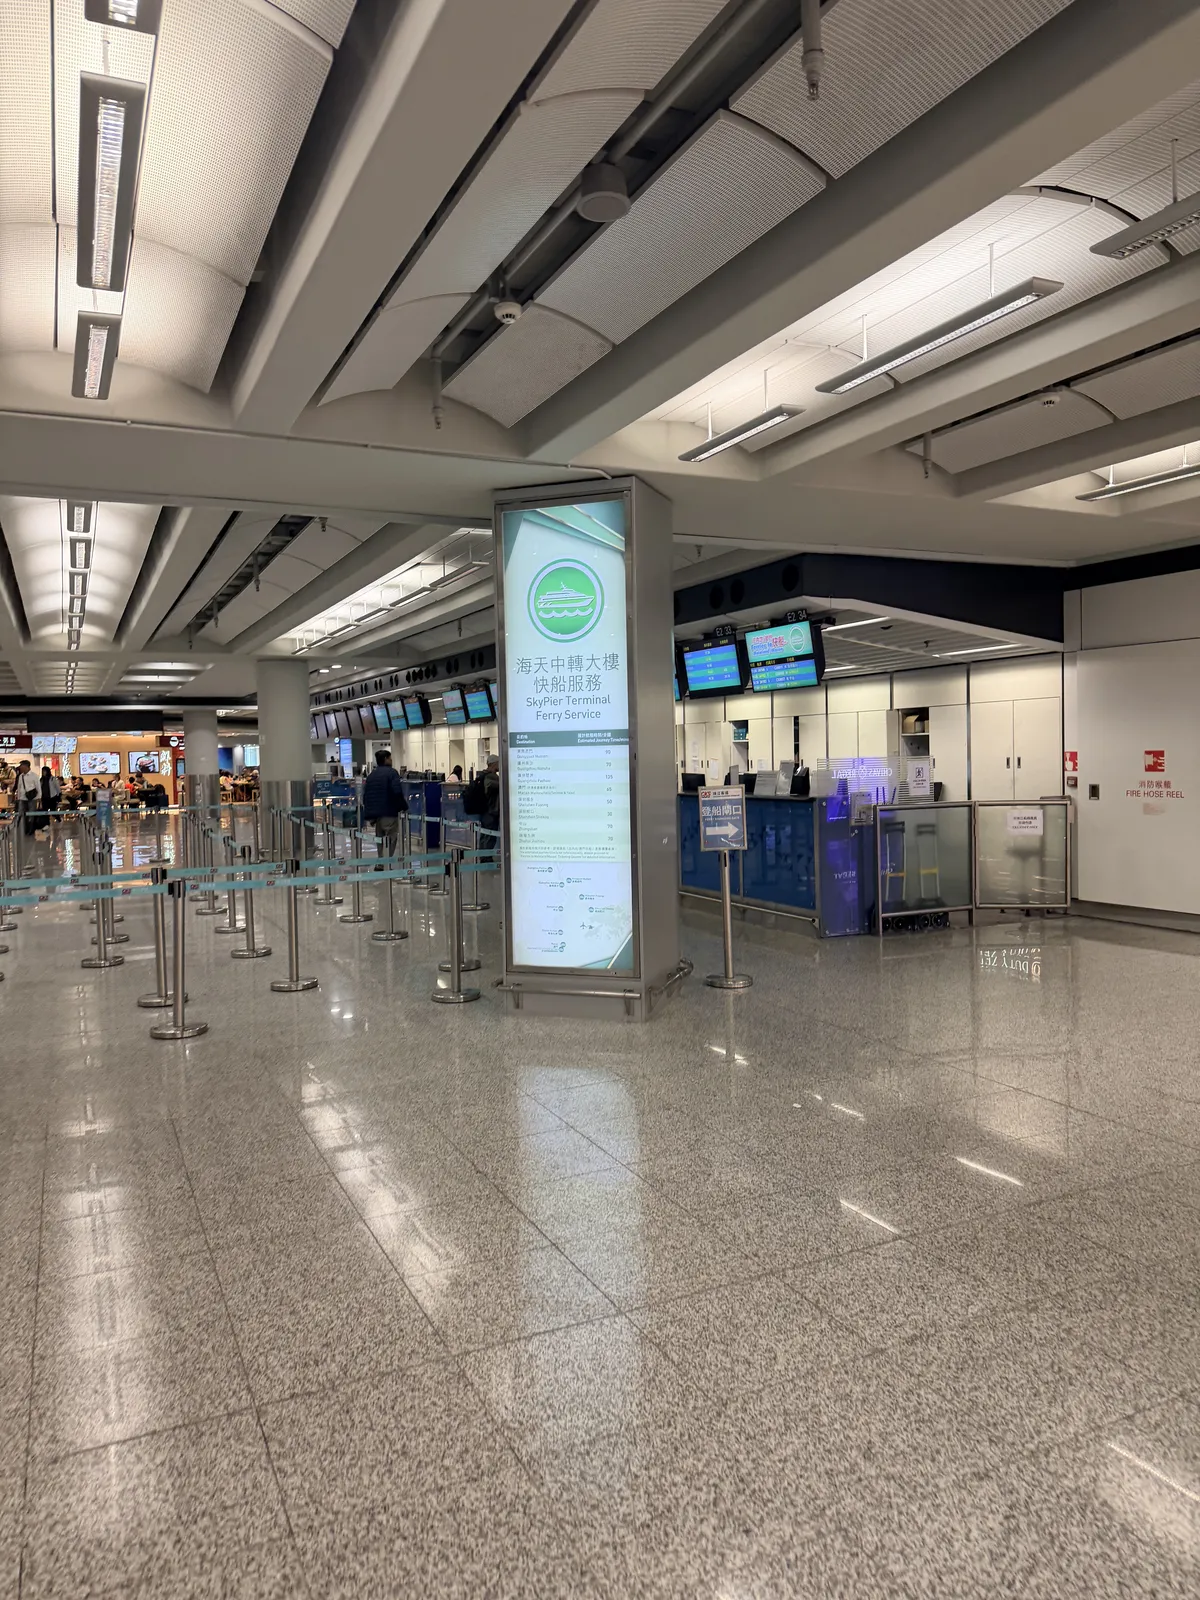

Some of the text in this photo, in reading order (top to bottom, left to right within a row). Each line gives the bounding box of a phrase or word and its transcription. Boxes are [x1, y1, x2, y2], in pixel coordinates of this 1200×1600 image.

[786, 609, 807, 622] E2 34
[715, 625, 732, 637] E2 33
[516, 652, 620, 675] 海天中轉大樓
[533, 673, 602, 694] 快船服務
[526, 694, 611, 709] SkyPier Terminal
[536, 708, 601, 722] Ferry Service
[1126, 790, 1185, 799] FIRE HOSE REEL
